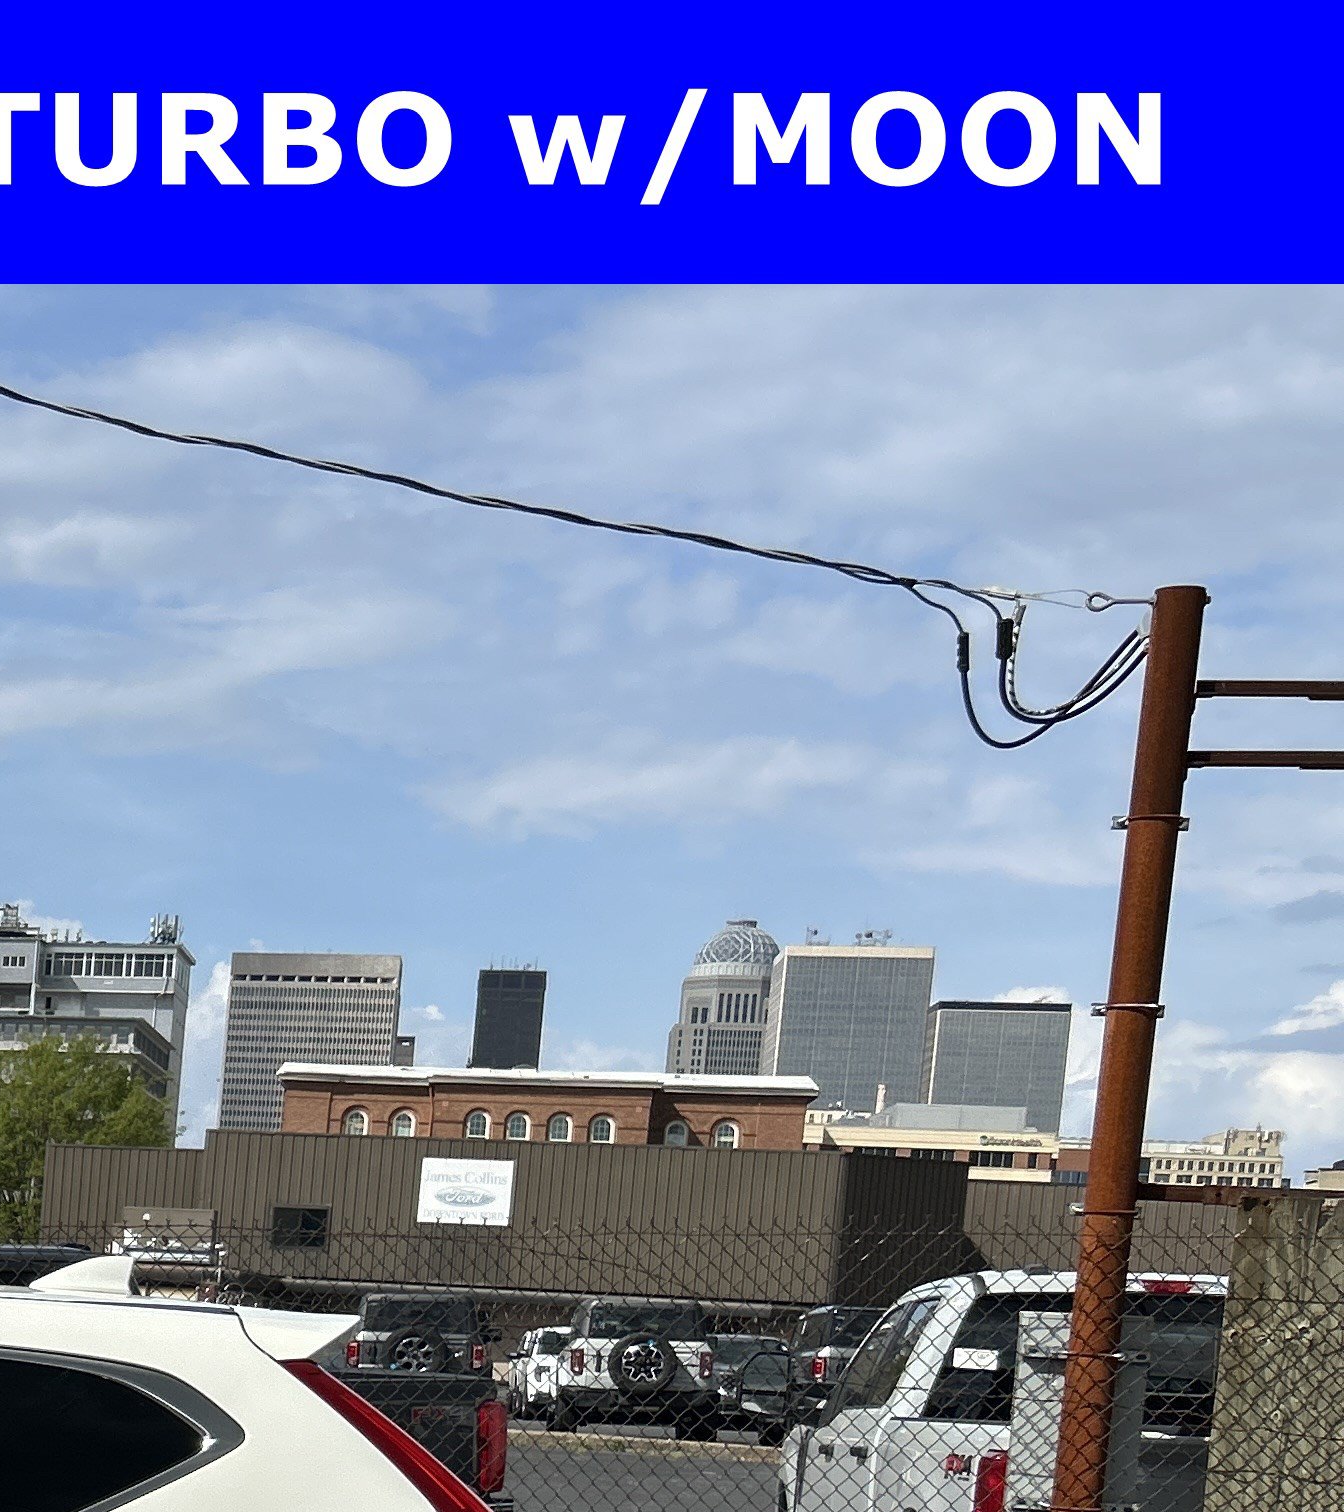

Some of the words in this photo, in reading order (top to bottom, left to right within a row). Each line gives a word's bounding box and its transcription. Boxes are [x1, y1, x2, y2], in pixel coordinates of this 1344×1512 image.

[424, 1169, 462, 1183] James
[464, 1171, 509, 1186] Collins
[445, 1188, 485, 1204] Ford
